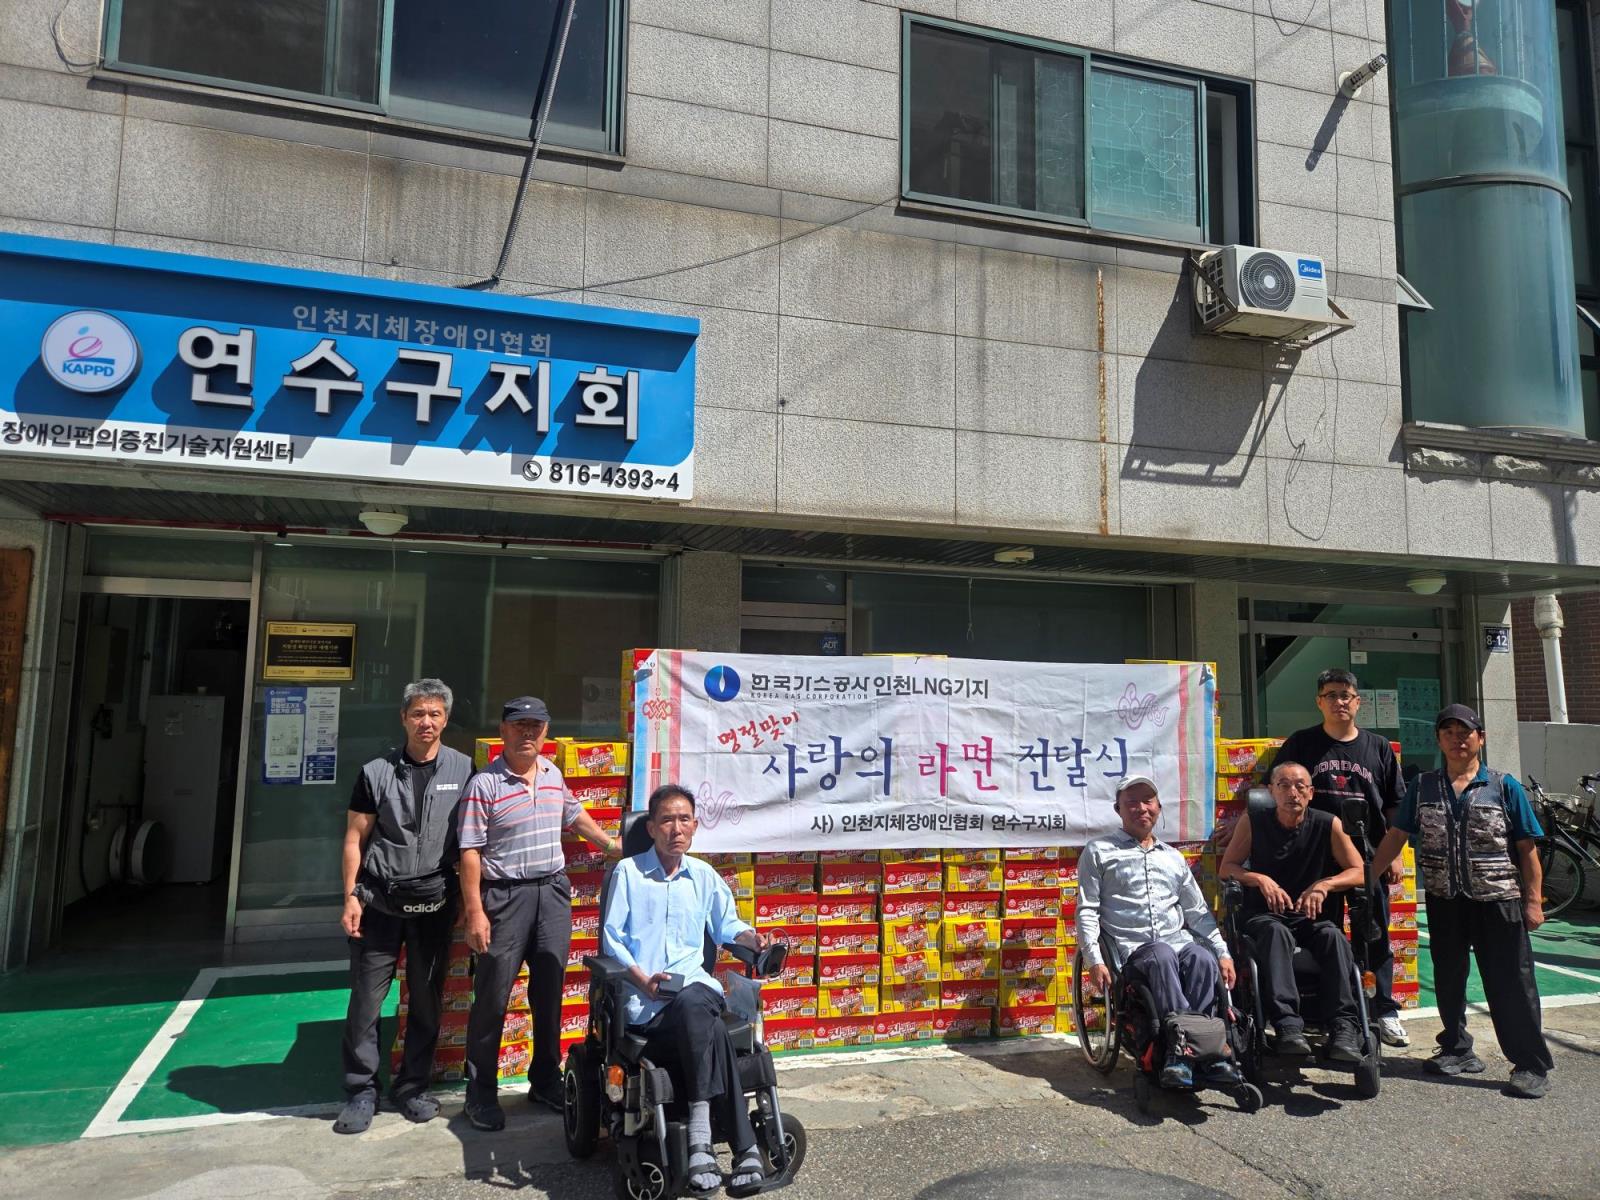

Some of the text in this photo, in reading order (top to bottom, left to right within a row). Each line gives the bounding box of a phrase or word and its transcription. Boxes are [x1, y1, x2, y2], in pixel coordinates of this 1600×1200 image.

[293, 305, 551, 357] 인천지체장애인협회
[62, 362, 115, 377] KAPPD
[177, 325, 640, 442] 연수구지회
[1, 420, 295, 464] 장애인편의증진기술지원센터
[550, 462, 680, 492] 816-4393~4
[1486, 634, 1508, 646] 8-12
[717, 711, 800, 753] 명절맞이
[762, 735, 1128, 799] 사랑의 라면 전달식
[1312, 759, 1373, 783] JORDAN
[810, 813, 1067, 834] 사) 인천지체장애인협회 연수구지회
